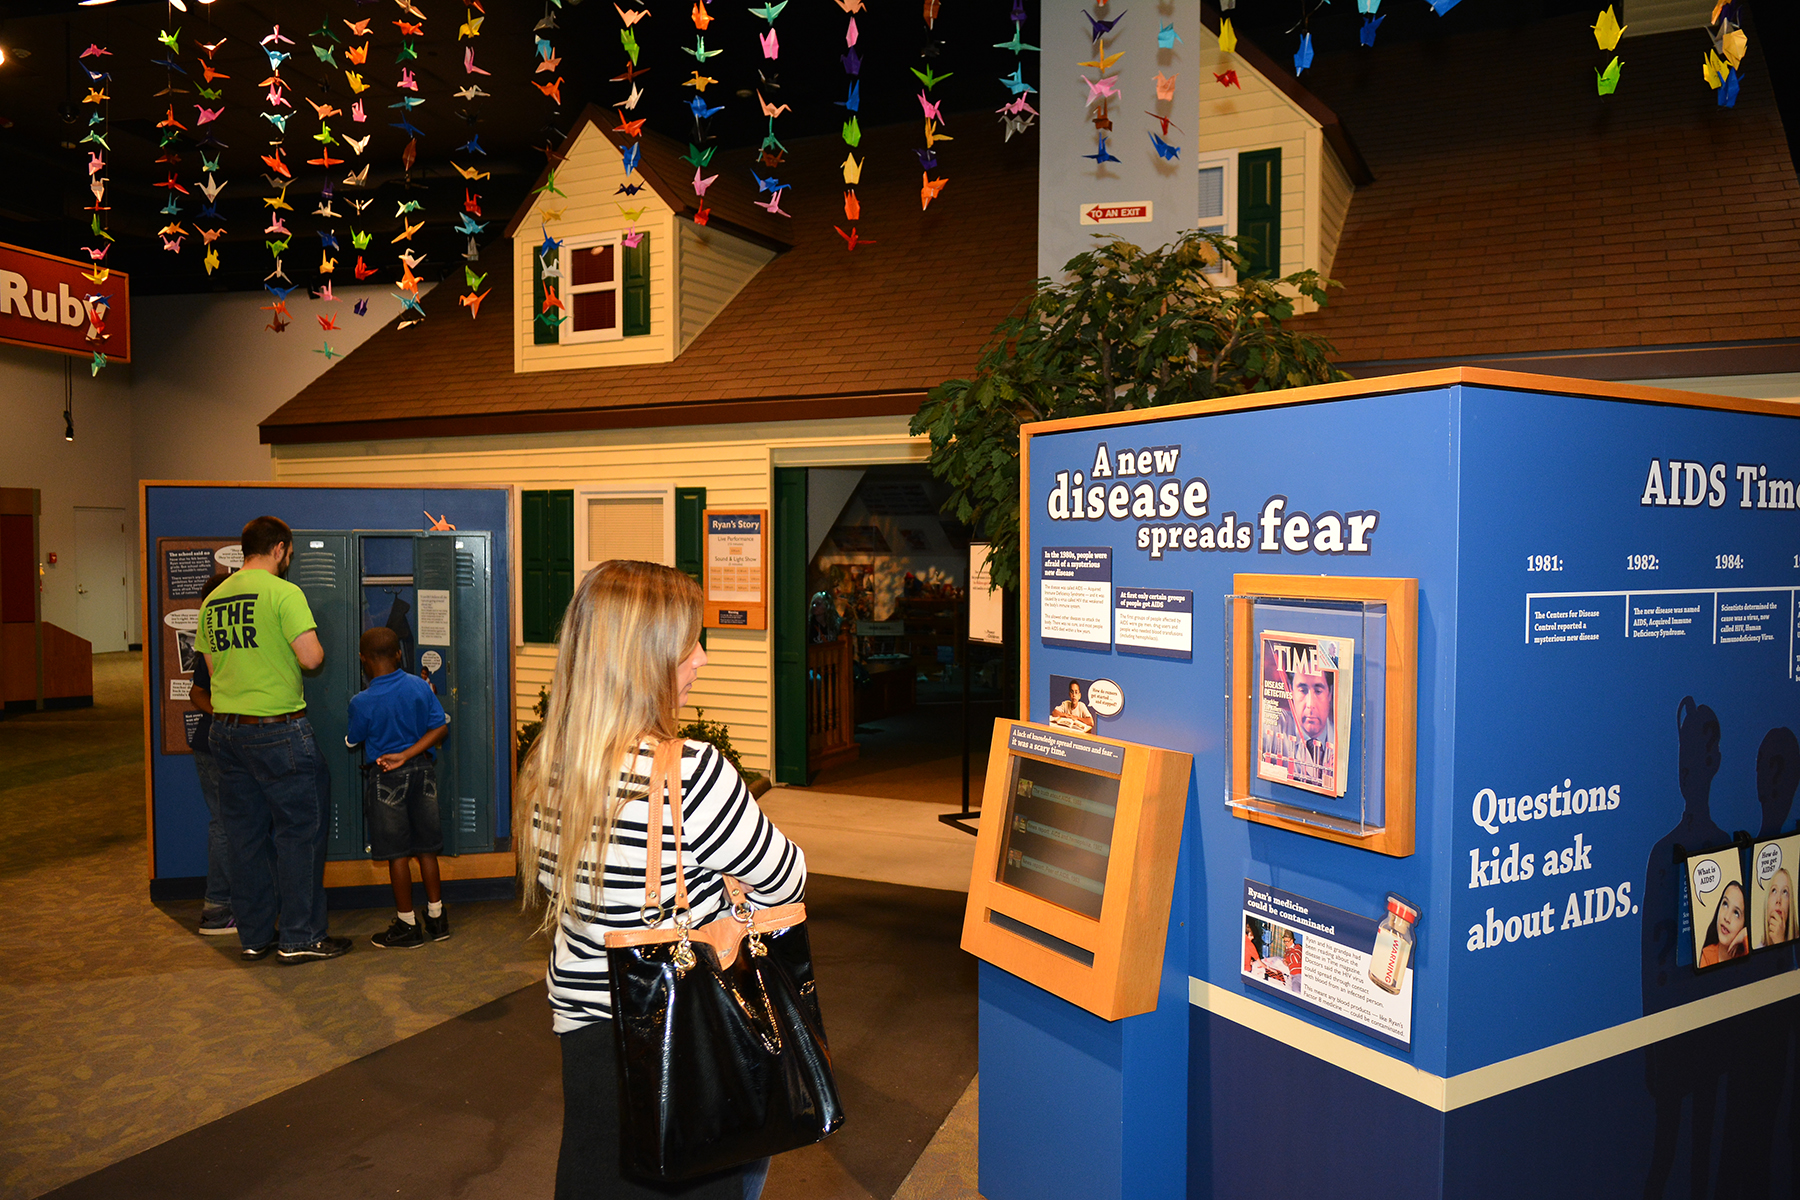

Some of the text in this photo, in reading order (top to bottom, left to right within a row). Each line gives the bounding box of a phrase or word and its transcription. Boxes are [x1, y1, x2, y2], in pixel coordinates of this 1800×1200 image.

[1121, 208, 1140, 216] EXIT
[0, 269, 107, 340] Ruby
[1092, 446, 1179, 478] A new
[1641, 459, 1727, 508] AIDS
[1047, 472, 1208, 520] disease
[713, 521, 759, 530] Ryan's Story
[1138, 498, 1377, 557] spreads fear
[1071, 561, 1100, 569] mysterious
[1077, 551, 1093, 560] people
[1527, 555, 1563, 572] 1981:
[1626, 554, 1659, 570] 1982:
[1715, 554, 1744, 569] 1984:
[1126, 600, 1141, 608] people
[1138, 592, 1148, 601] only
[1744, 602, 1769, 611] determined
[214, 602, 255, 628] THE
[1535, 611, 1545, 619] The
[1569, 610, 1578, 618] for
[1579, 609, 1599, 617] Disease
[1684, 605, 1700, 613] named
[207, 608, 217, 653] RAISING
[1535, 622, 1556, 631] Control
[1558, 621, 1583, 632] reported
[1633, 618, 1648, 627] AIDS,
[1649, 617, 1671, 627] Acquired
[215, 625, 259, 652] BAR
[1534, 633, 1566, 645] mysterious
[1579, 633, 1599, 641] disease
[1633, 628, 1686, 638] Deficiency Syndrome.
[1721, 634, 1761, 643] Immunodeficiency
[1273, 644, 1322, 677] TIME
[1264, 680, 1284, 690] DISEASE
[1264, 688, 1292, 699] DETECTIVES
[1012, 737, 1017, 745] it
[1018, 740, 1028, 748] was
[1034, 744, 1050, 755] scary
[1051, 747, 1066, 757] time.
[1017, 730, 1026, 738] lack
[1032, 733, 1056, 746] knowledge
[1057, 740, 1072, 748] spread
[1073, 743, 1090, 752] rumors
[1102, 748, 1112, 756] fear
[1472, 778, 1621, 835] Questions
[1468, 833, 1592, 889] kids ask
[1762, 865, 1775, 874] AIDS?
[1698, 867, 1711, 876] What
[1700, 876, 1715, 885] AIDS?
[1248, 887, 1308, 915] Ryan's medicine
[1247, 900, 1335, 935] could be contaminated
[1466, 902, 1555, 951] about
[1560, 881, 1639, 930] AIDS.
[1306, 936, 1316, 944] Ryan
[1334, 947, 1351, 957] grandpa
[1305, 950, 1320, 959] disease
[1327, 958, 1338, 967] Time
[1340, 964, 1361, 975] magazine.
[1305, 957, 1323, 968] Doctors
[1343, 970, 1351, 978] HIV
[1352, 976, 1364, 984] virus
[1385, 940, 1398, 983] WARNING
[1315, 976, 1327, 986] blood
[1329, 981, 1339, 990] from
[1347, 989, 1365, 1000] infected
[1366, 997, 1384, 1008] person.
[1304, 991, 1317, 1000] Factor
[1323, 999, 1342, 1011] medicine
[1350, 1010, 1363, 1020] could
[1371, 1018, 1404, 1037] contaminated.
[1314, 989, 1327, 998] meant
[1337, 997, 1350, 1007] blood
[1351, 1003, 1371, 1015] products
[1379, 1014, 1387, 1022] like
[1388, 1017, 1403, 1028] Ryan's
